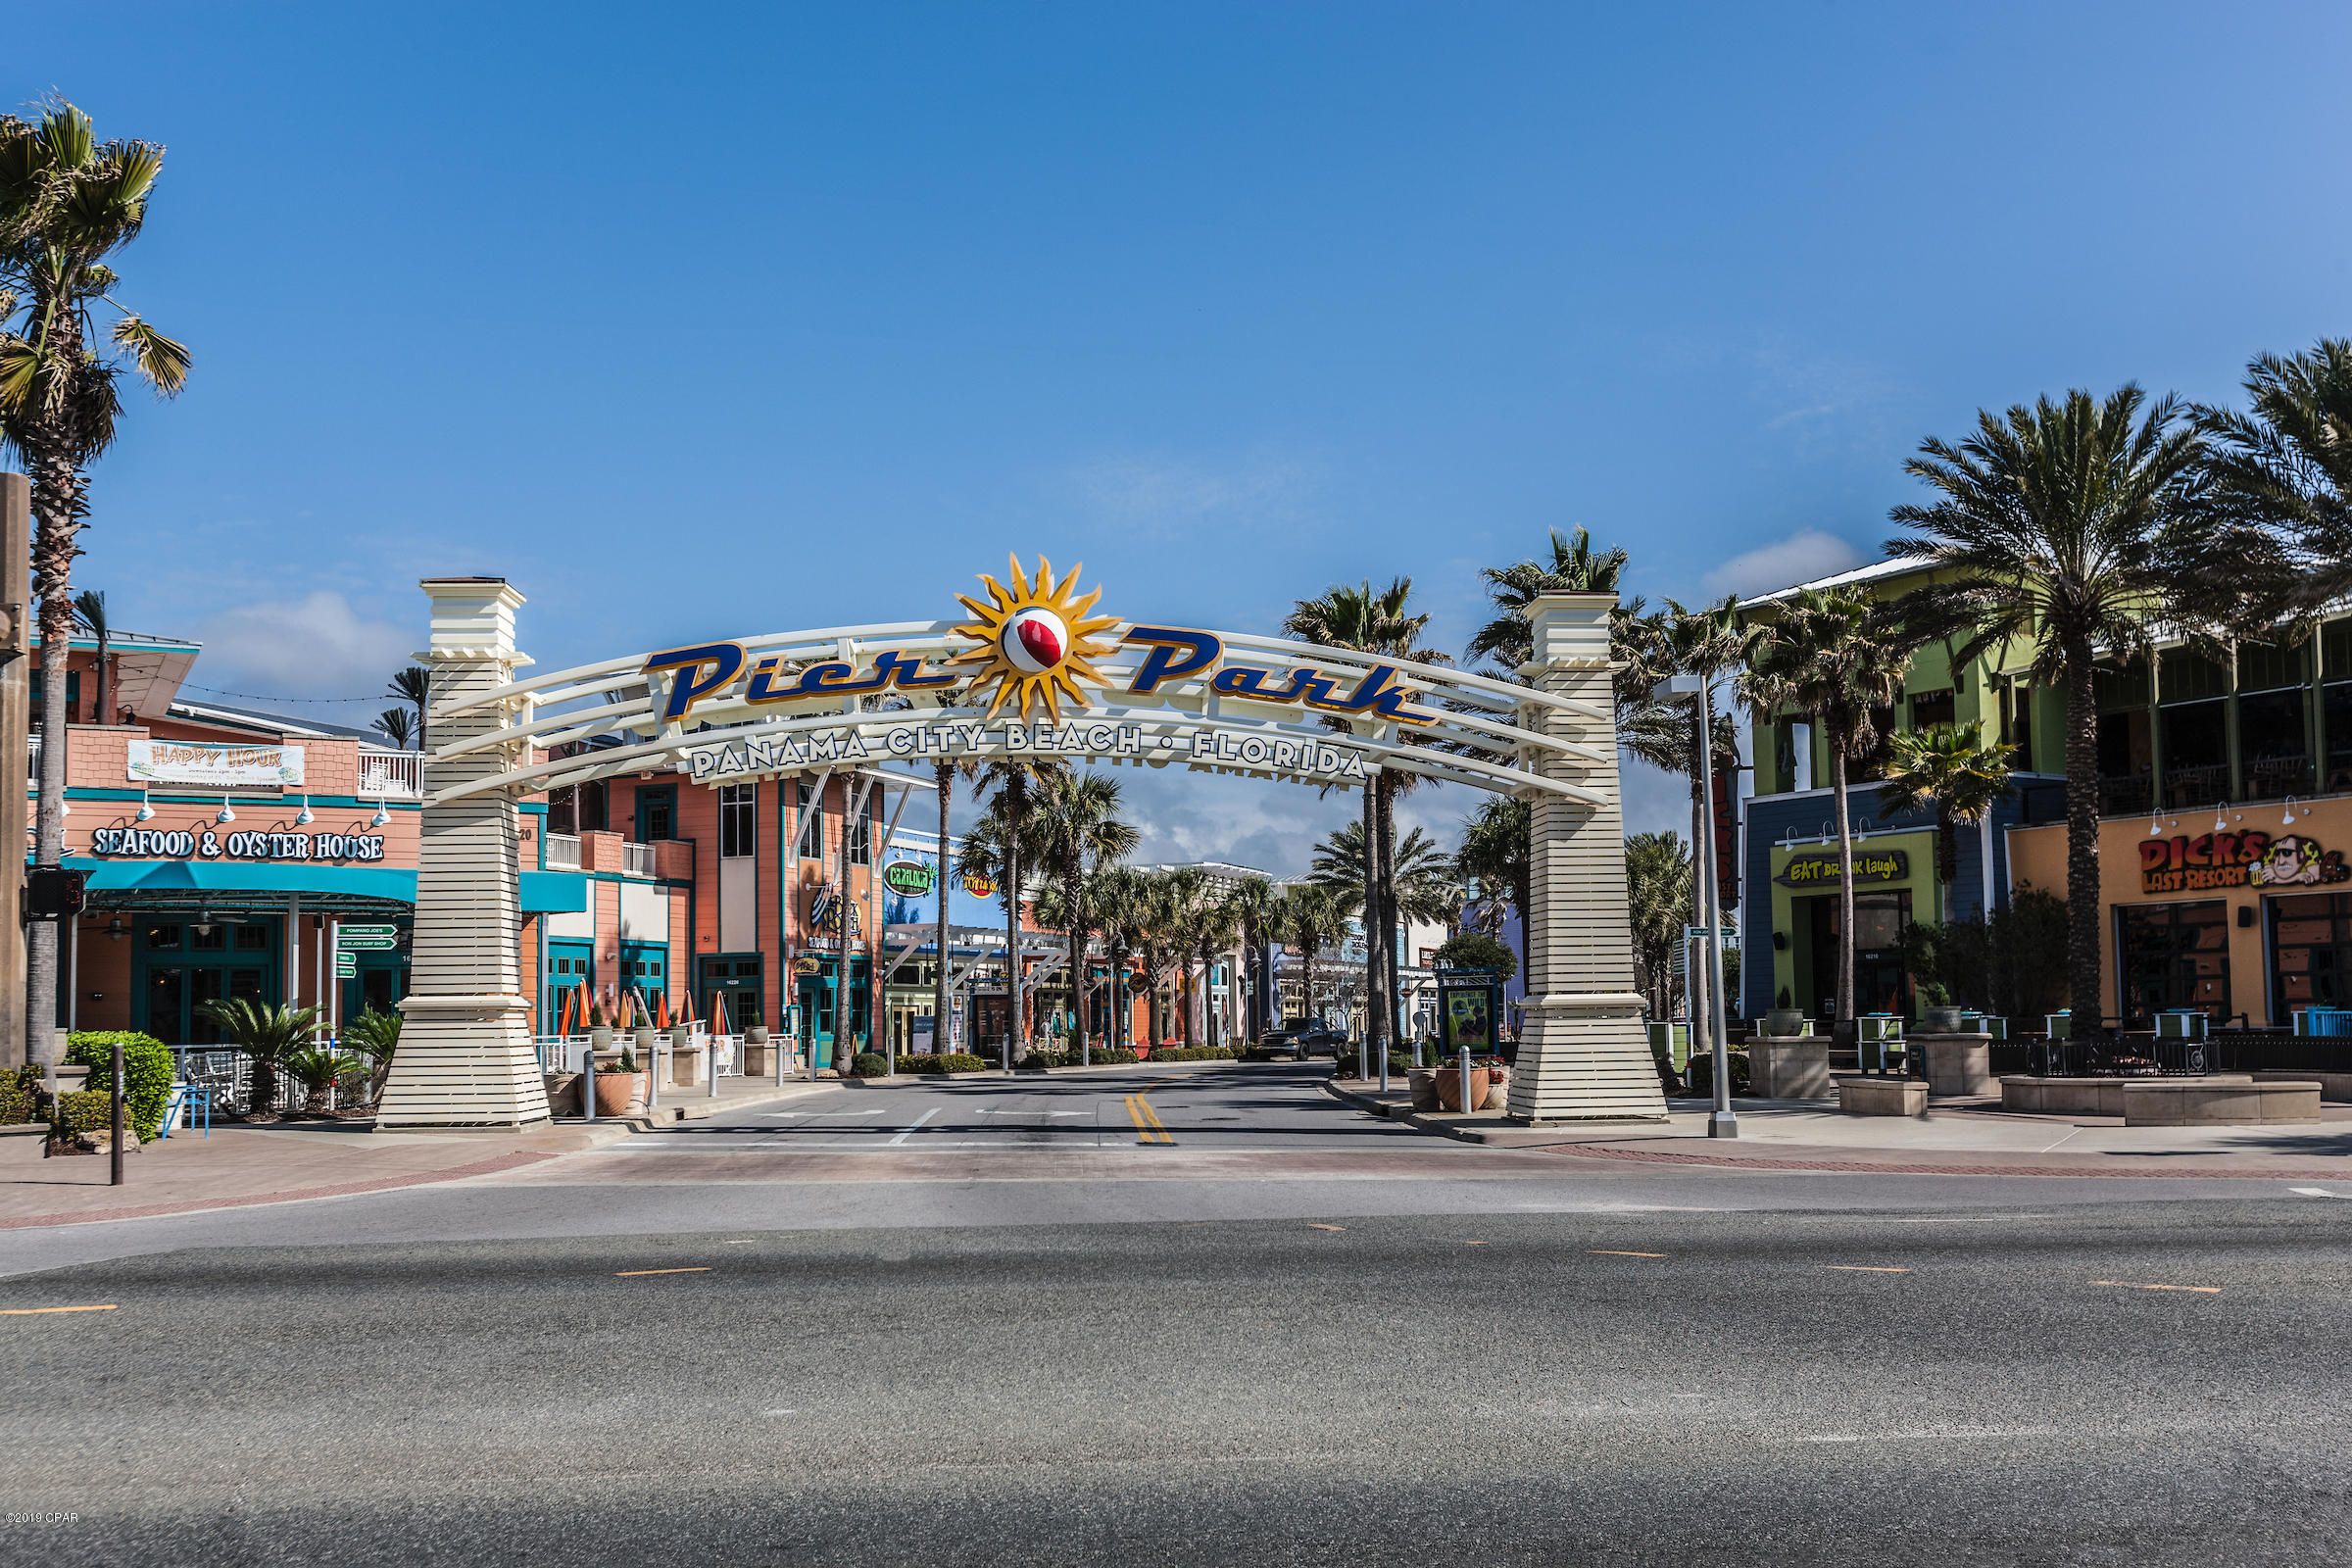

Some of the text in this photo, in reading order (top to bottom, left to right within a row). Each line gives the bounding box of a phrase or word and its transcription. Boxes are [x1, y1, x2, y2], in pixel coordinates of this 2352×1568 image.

[639, 624, 1442, 727] Pier Park
[151, 744, 282, 767] HAPPY HOUR
[691, 721, 1367, 780] PANAMA CITY BEACH FLORIDA
[95, 828, 194, 858] SEAFOOD
[202, 831, 221, 858] &
[228, 831, 310, 858] OYSTER
[314, 834, 385, 859] HOUSE
[2138, 832, 2265, 871] DICK'S
[1790, 855, 1898, 881] EAT DRNK laugh
[2141, 866, 2248, 893] LAST RESORT
